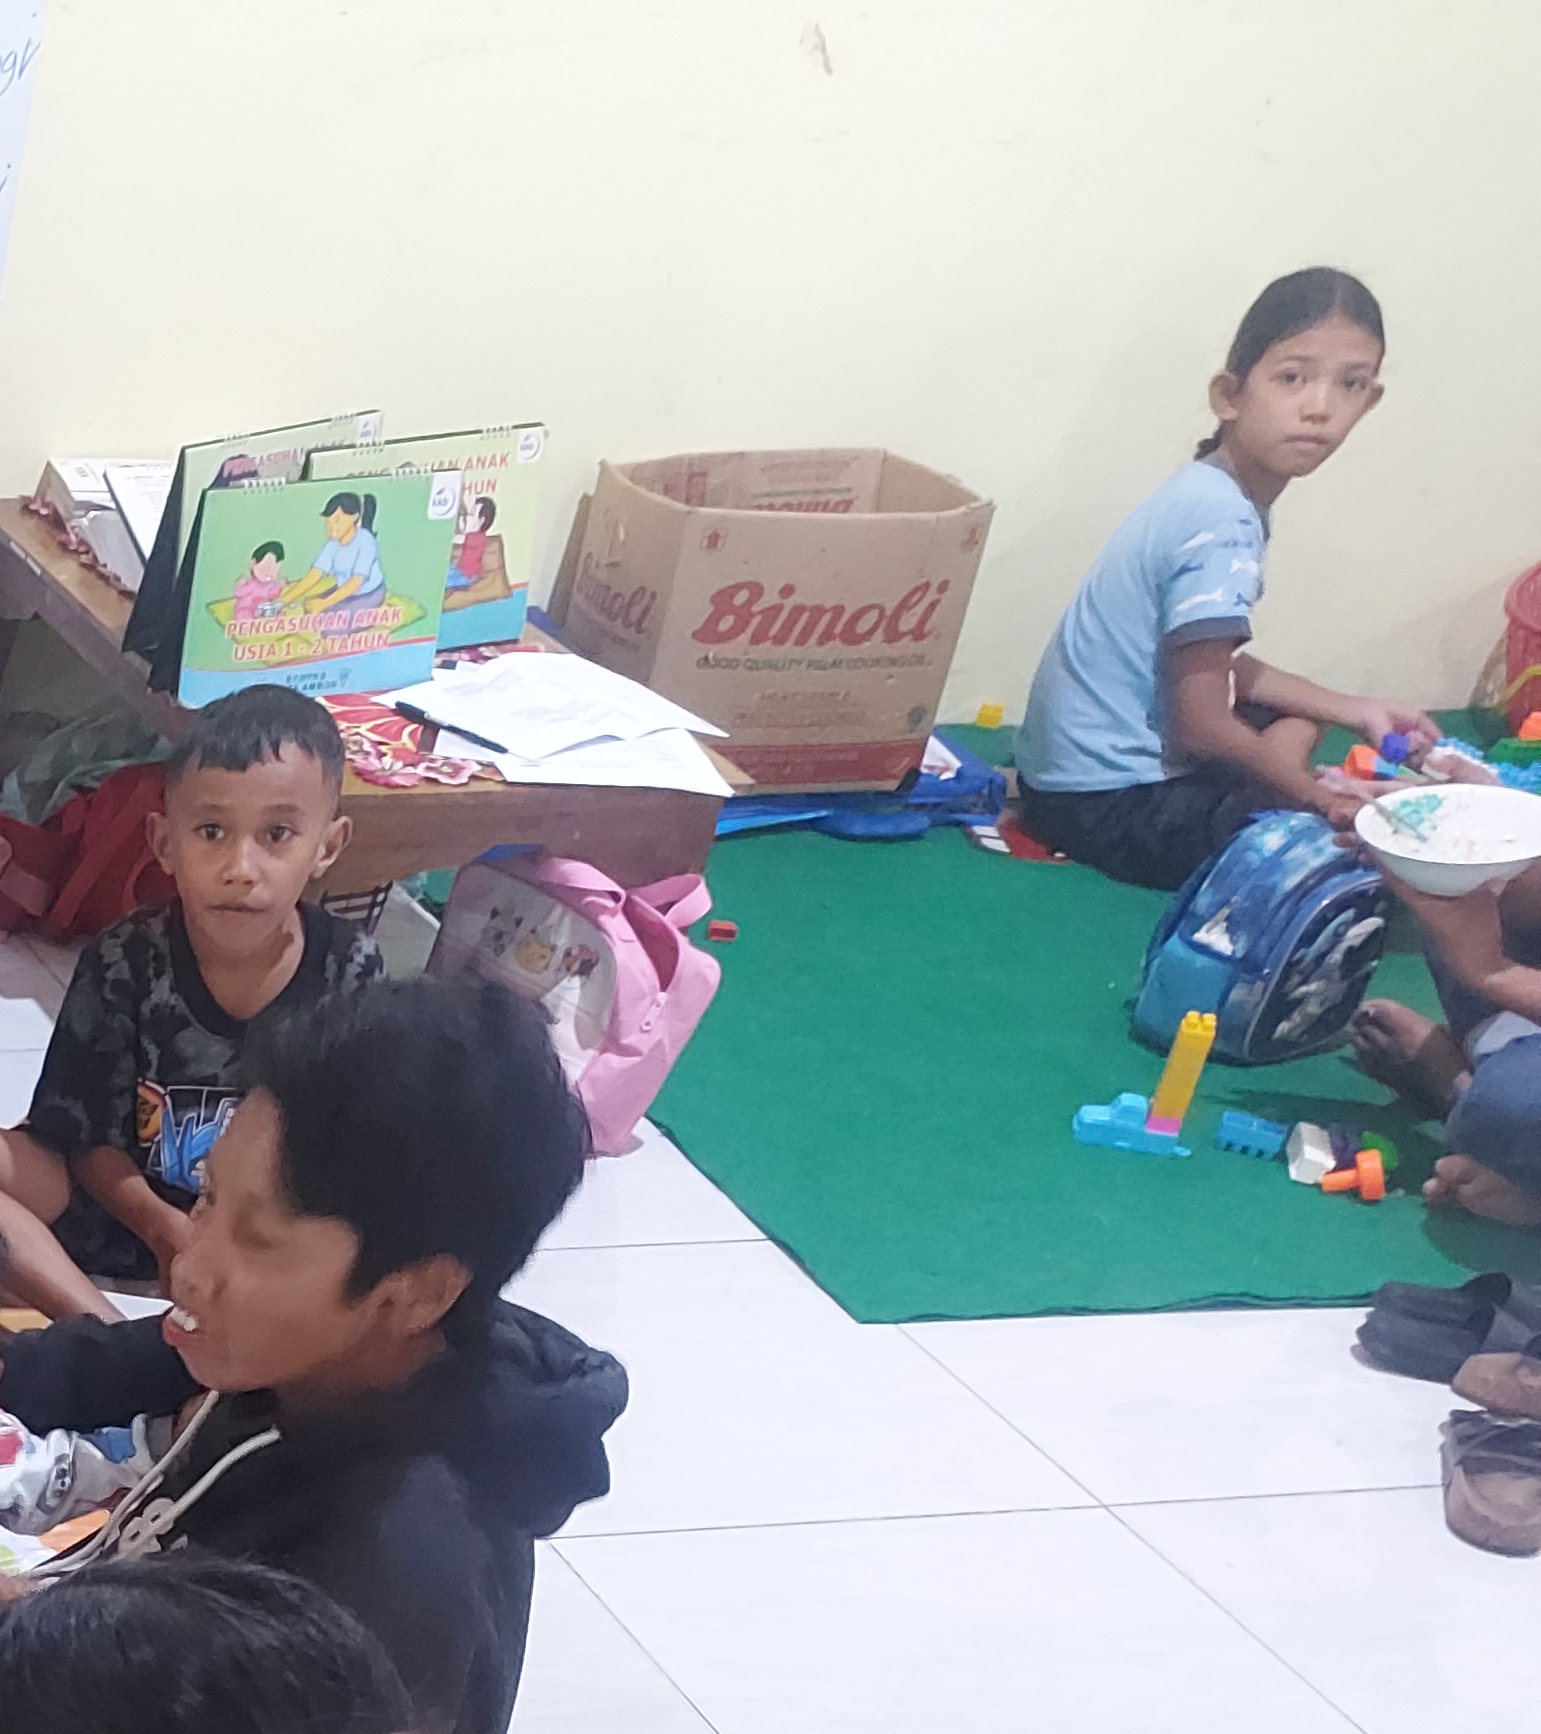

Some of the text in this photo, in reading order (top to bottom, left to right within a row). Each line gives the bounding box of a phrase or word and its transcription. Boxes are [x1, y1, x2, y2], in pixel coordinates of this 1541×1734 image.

[464, 450, 511, 472] ANAK
[352, 606, 404, 628] ANAK
[691, 578, 950, 648] Bimoli
[234, 641, 277, 662] USIA
[282, 641, 294, 658] 1
[311, 638, 324, 656] 2
[327, 632, 391, 653] TAHUN
